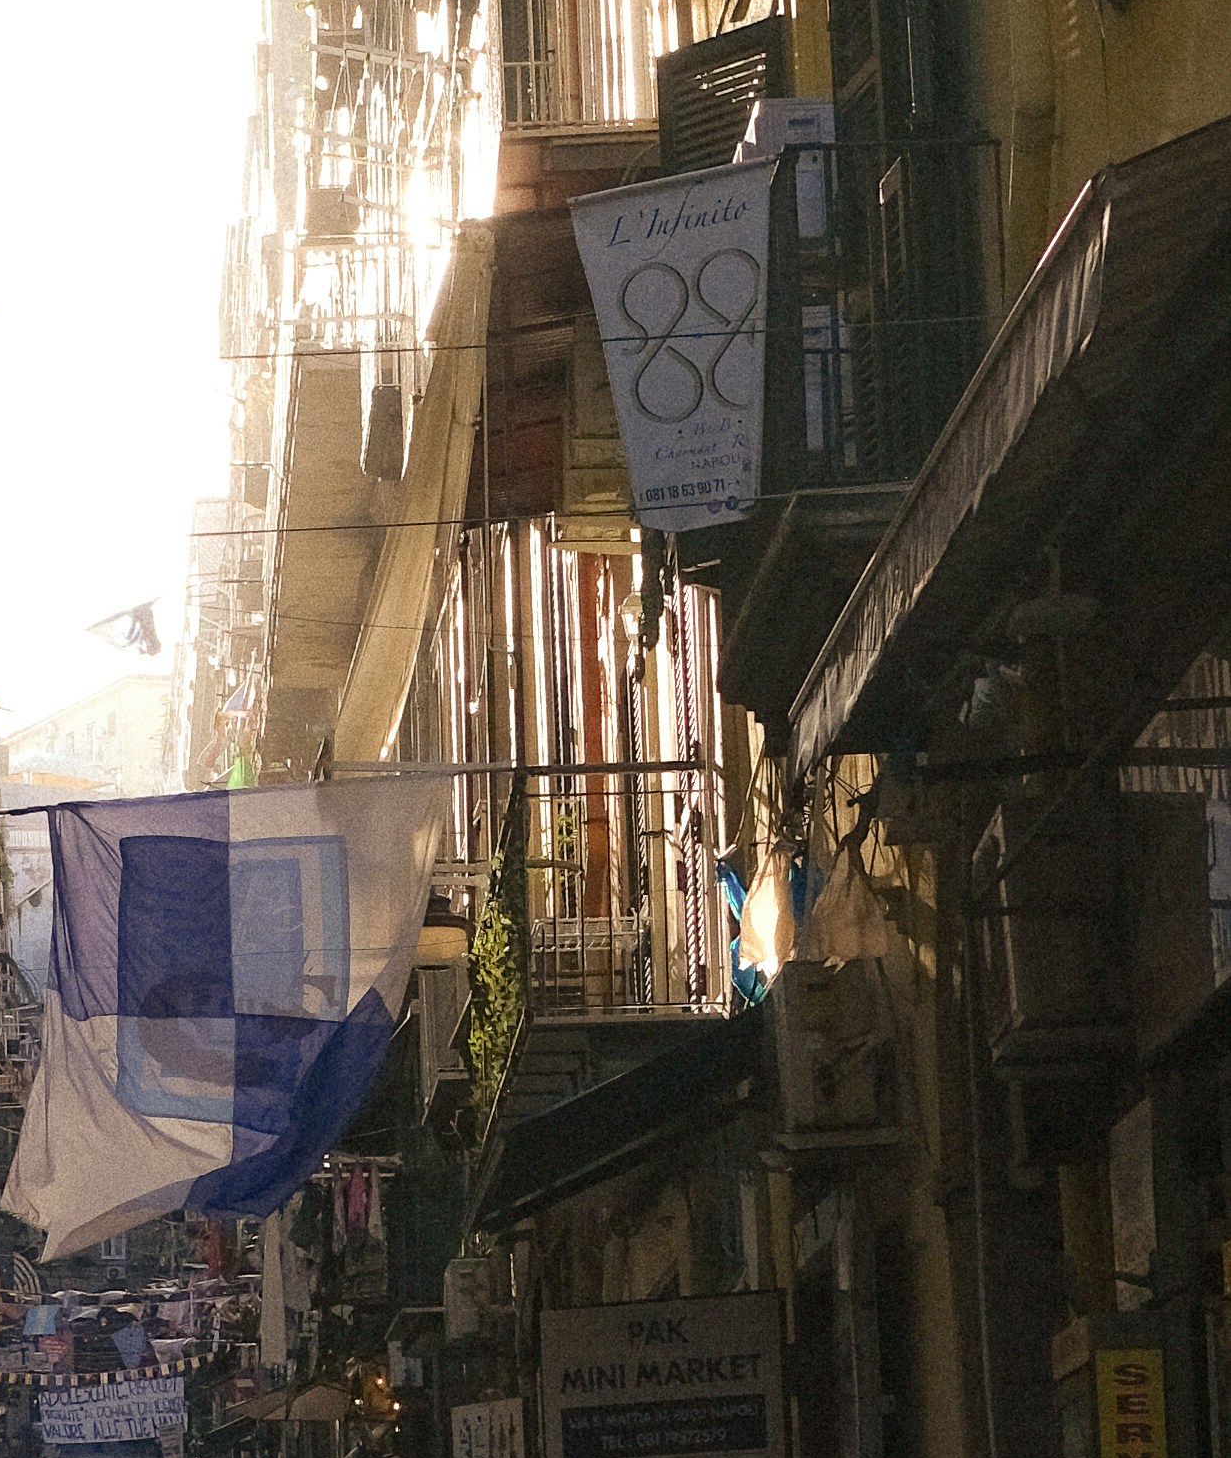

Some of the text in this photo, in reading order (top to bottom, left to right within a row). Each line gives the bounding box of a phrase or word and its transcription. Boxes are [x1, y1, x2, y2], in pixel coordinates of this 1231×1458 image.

[607, 179, 751, 261] L'Infinito
[691, 453, 741, 470] NAPOLI
[645, 478, 725, 502] 081 18 63 90 71
[628, 1316, 689, 1345] PAK
[561, 1354, 762, 1393] MINI MARKET
